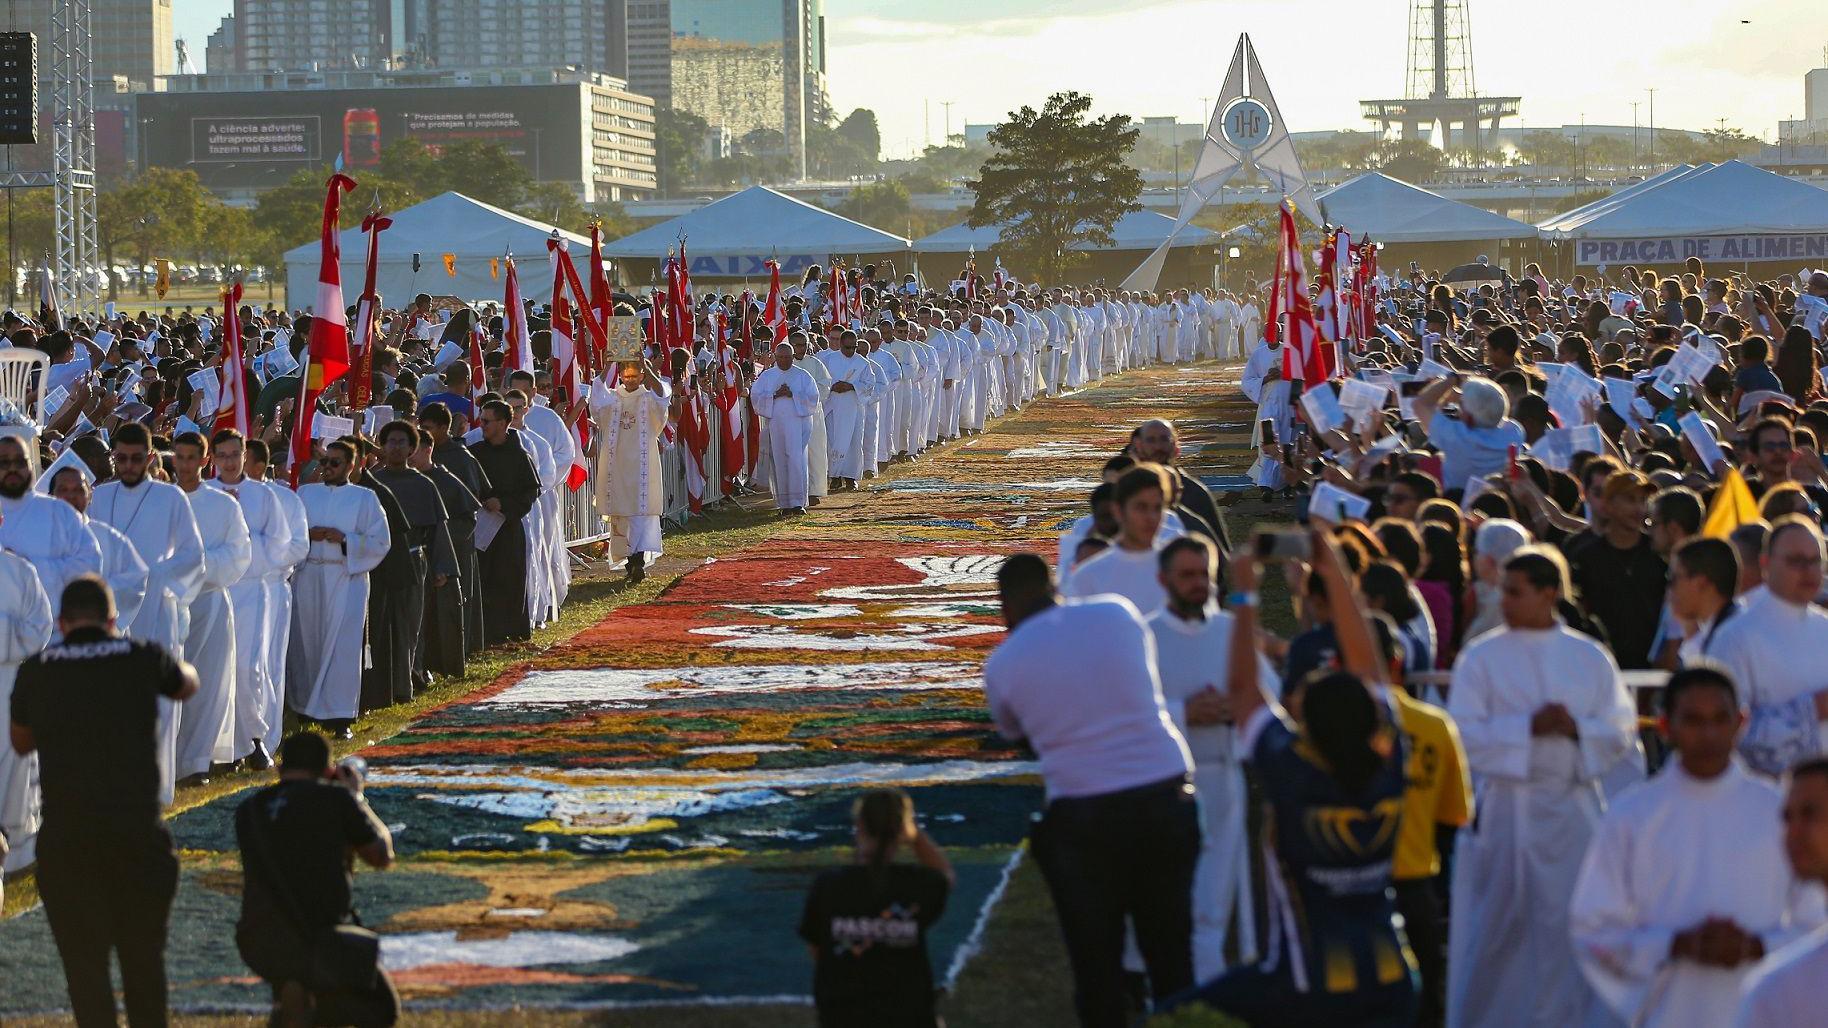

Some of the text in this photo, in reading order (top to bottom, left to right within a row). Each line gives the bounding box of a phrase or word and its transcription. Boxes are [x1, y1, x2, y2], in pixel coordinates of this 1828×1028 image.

[465, 112, 477, 120] de
[479, 112, 515, 120] medidas
[209, 123, 305, 134] A ciência adverte:
[409, 121, 426, 130] que
[427, 120, 466, 129] protejam
[209, 134, 304, 144] ultraprocessados
[209, 144, 240, 154] fazem
[242, 144, 261, 153] mal
[272, 143, 307, 153] saúde.
[1581, 236, 1828, 263] PRAÇA DE ALIMEN
[41, 641, 131, 664] PASCOM
